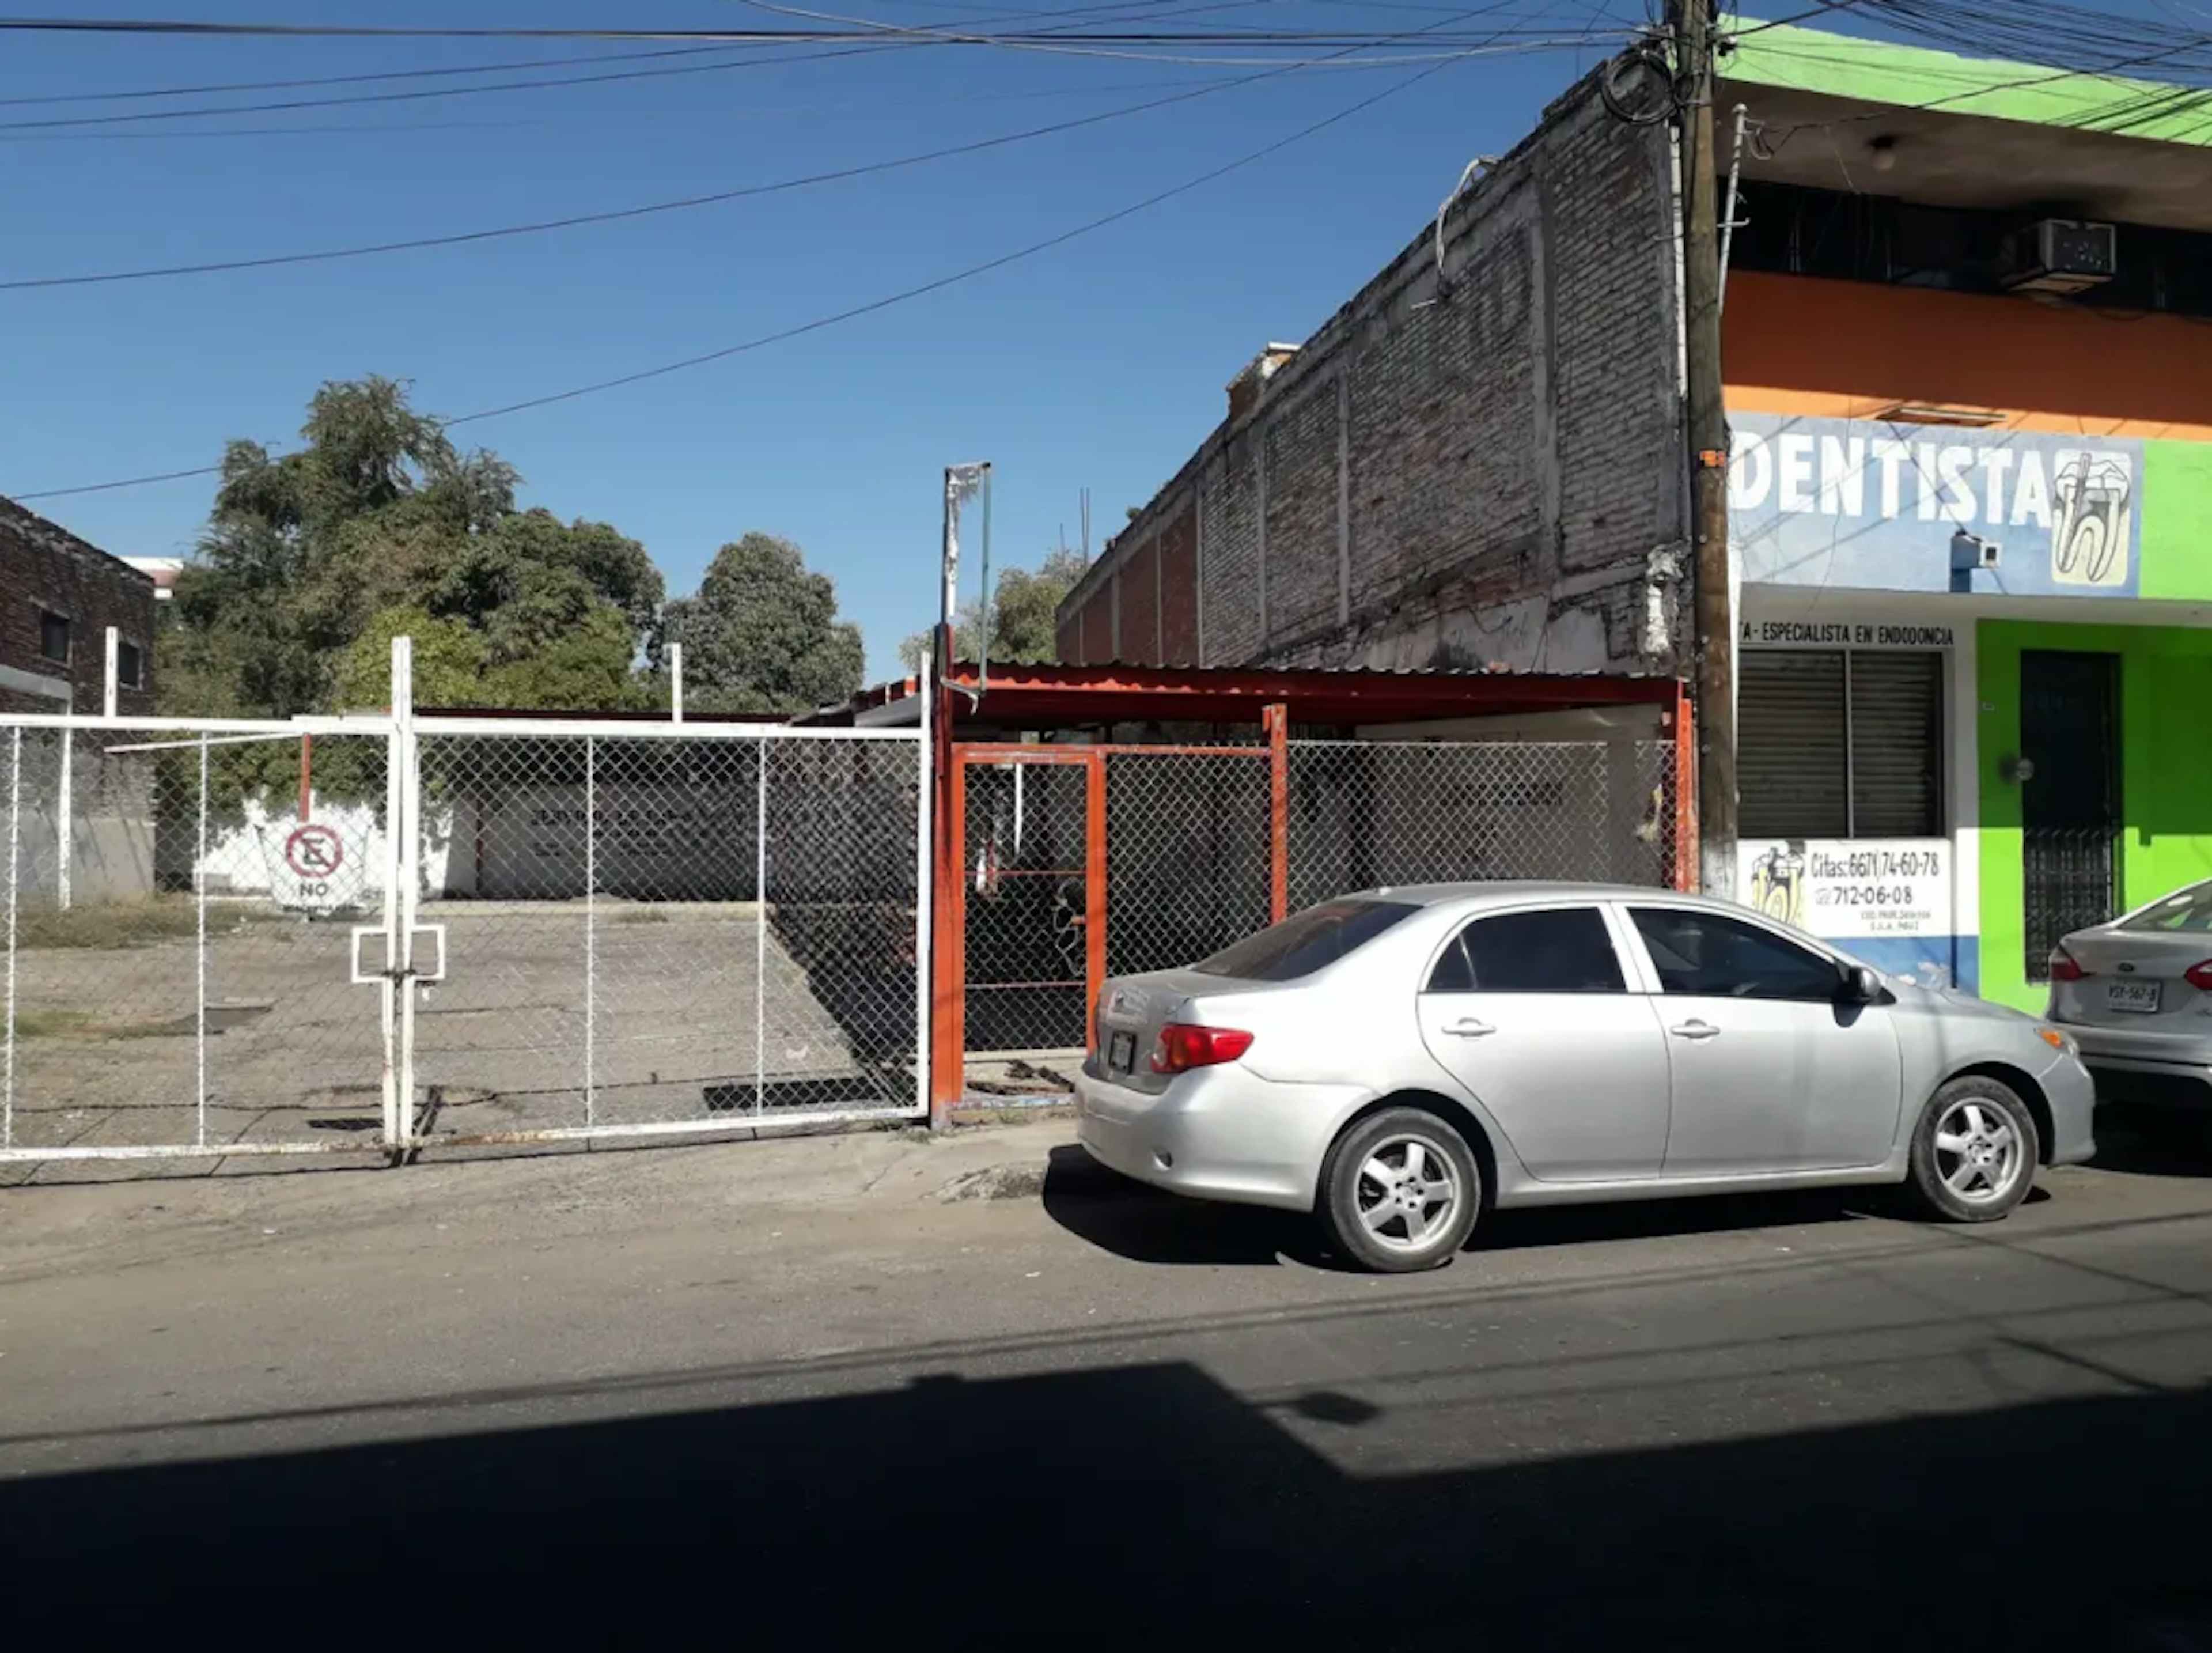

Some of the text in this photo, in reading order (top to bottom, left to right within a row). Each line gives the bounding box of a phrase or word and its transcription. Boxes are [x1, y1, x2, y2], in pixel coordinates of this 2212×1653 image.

[1729, 430, 2052, 527] DENTISTA
[1763, 621, 1850, 642] ESPECIALISTA
[1856, 625, 1873, 643] EN
[1878, 625, 1953, 645] ENDODONCIA
[300, 883, 329, 896] NO
